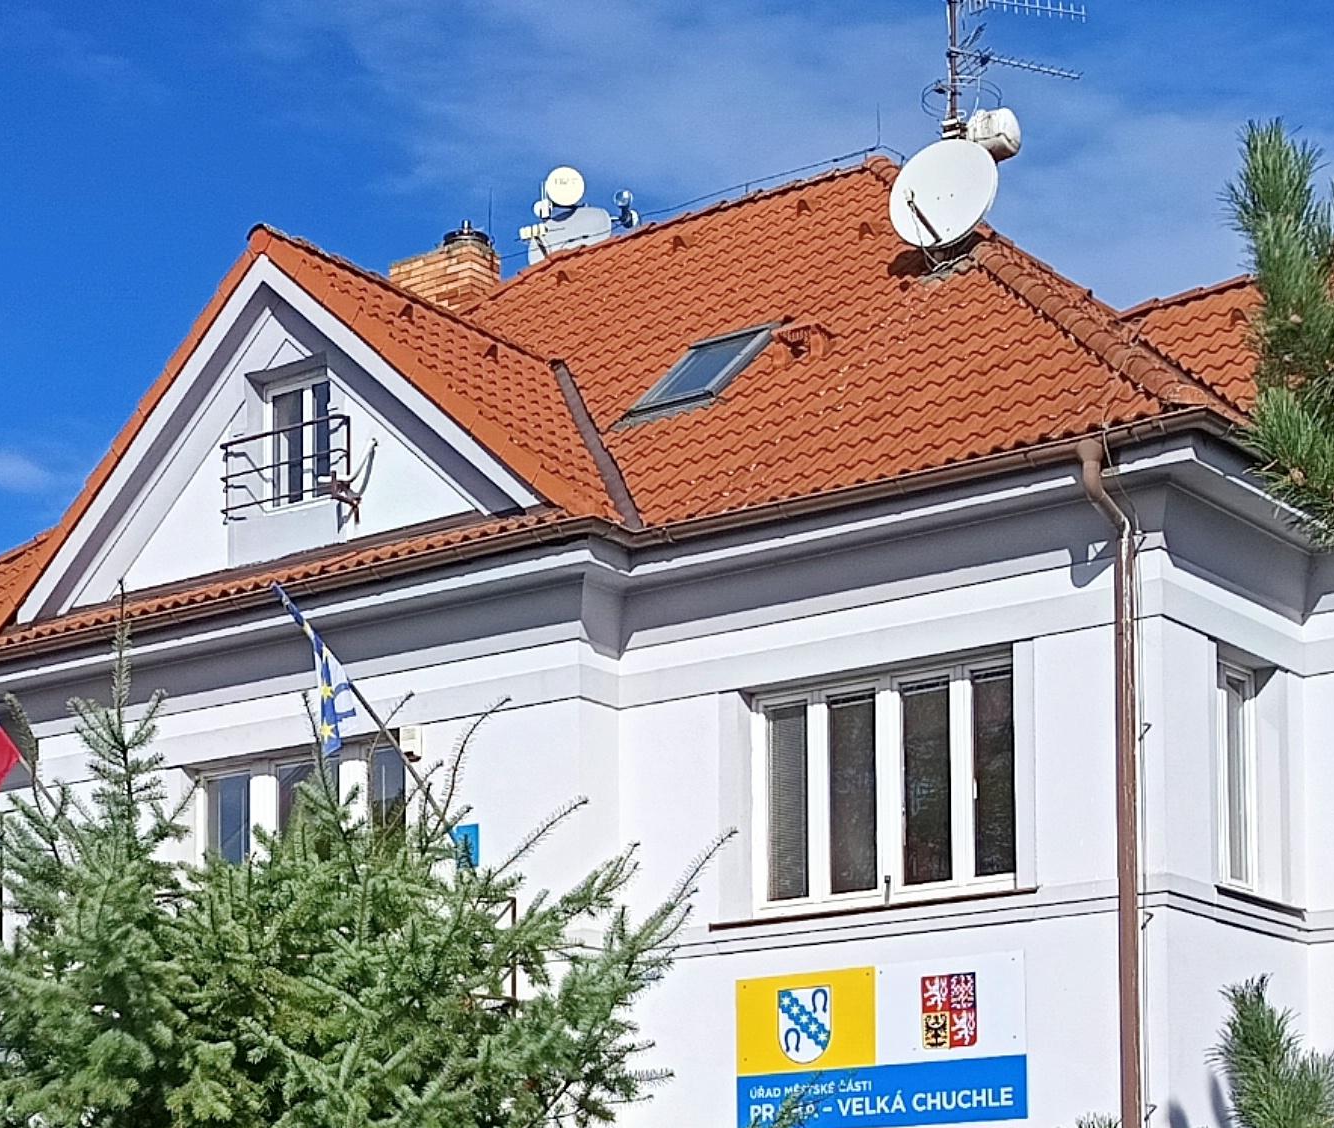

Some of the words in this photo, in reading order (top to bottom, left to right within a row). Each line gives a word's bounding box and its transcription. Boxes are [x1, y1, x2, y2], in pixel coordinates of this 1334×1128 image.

[749, 1085, 782, 1099] ÚŘAD
[838, 1078, 872, 1092] ČÁSTI
[837, 1090, 907, 1117] VELKÁ
[912, 1087, 1014, 1112] CHUCHLE
